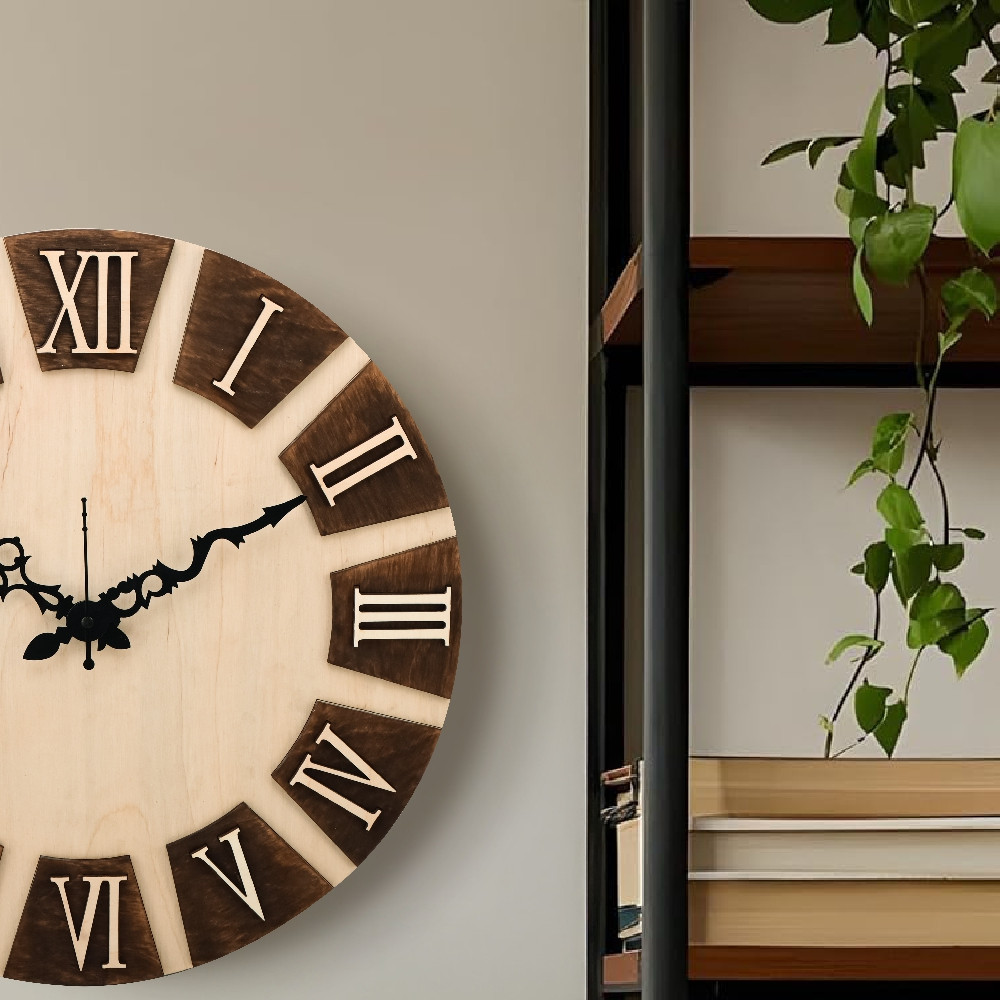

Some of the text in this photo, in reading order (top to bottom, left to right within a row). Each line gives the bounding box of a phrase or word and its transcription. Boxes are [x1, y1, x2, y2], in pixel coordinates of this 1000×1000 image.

[37, 251, 139, 354] XII
[213, 297, 285, 397] I
[310, 416, 418, 507] II
[353, 586, 452, 648] III
[290, 723, 397, 832] IV
[192, 828, 266, 922] V
[51, 876, 128, 972] VI
